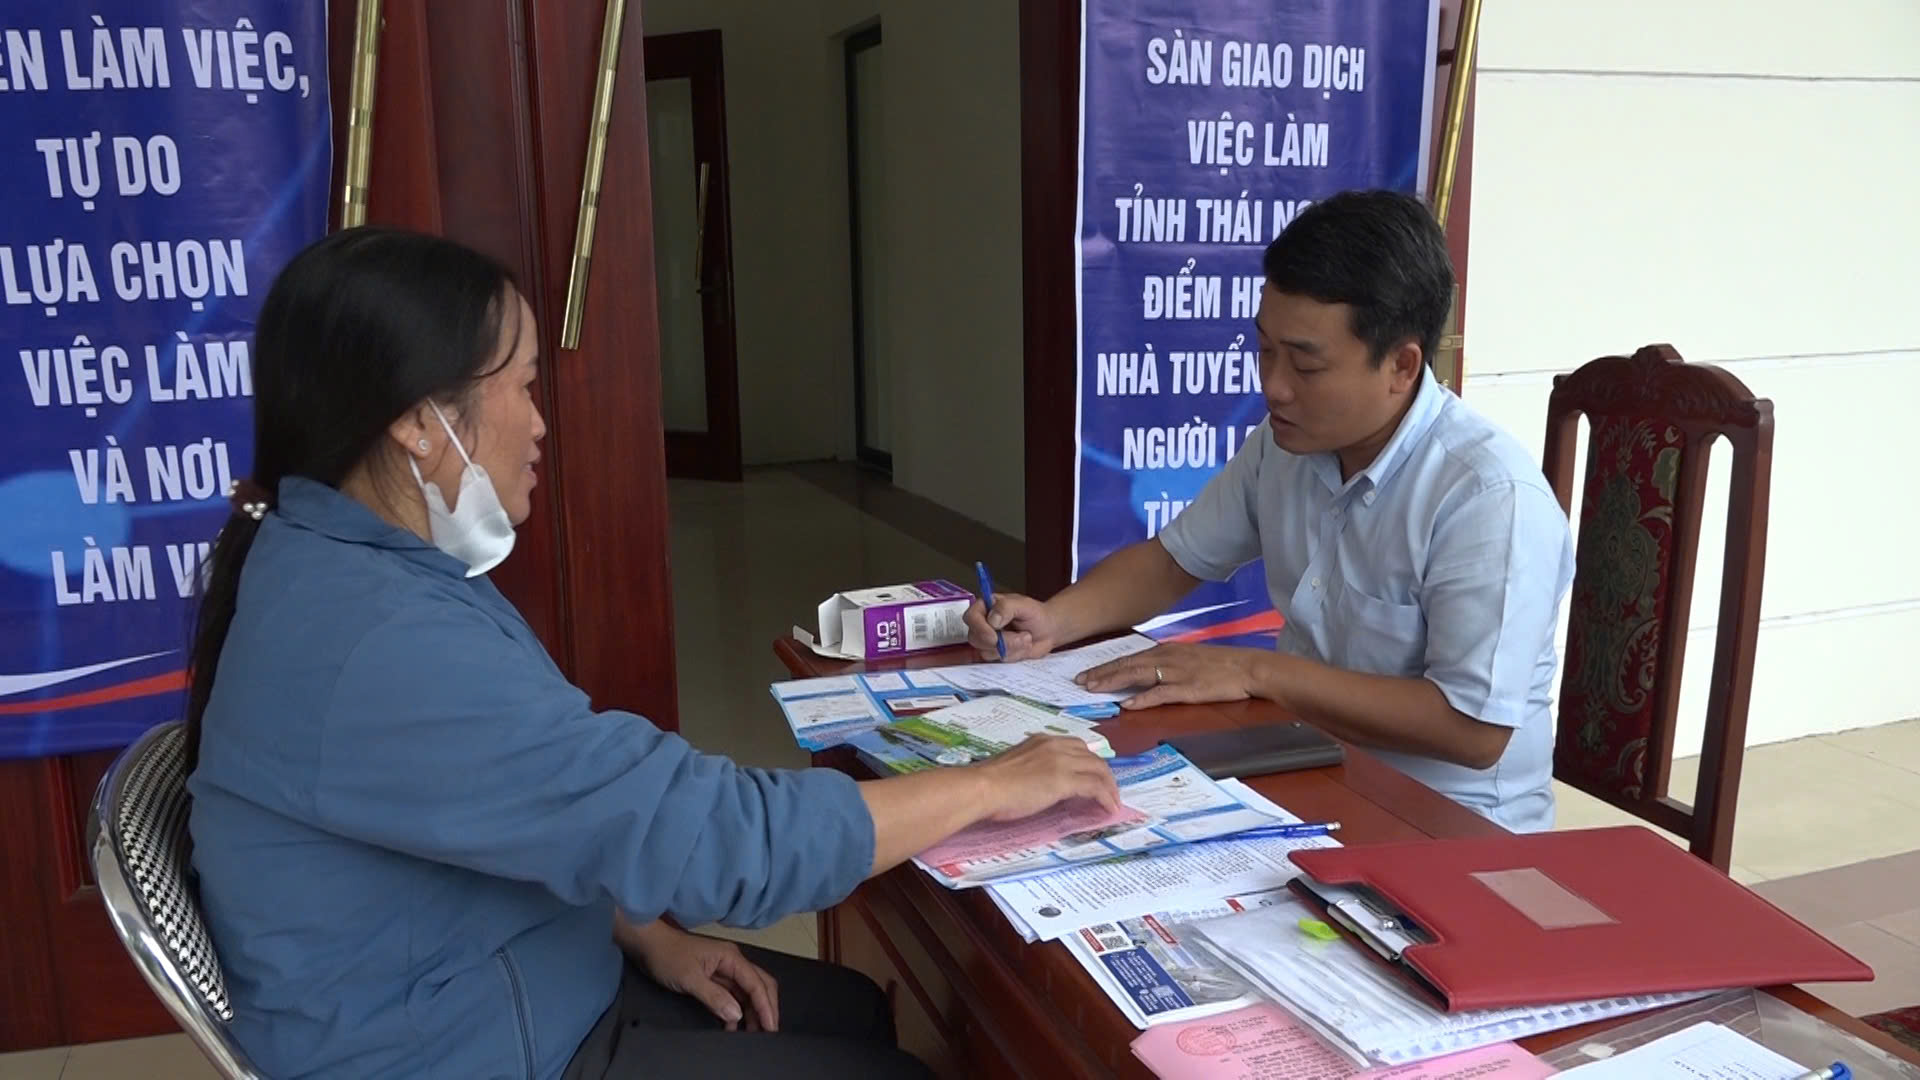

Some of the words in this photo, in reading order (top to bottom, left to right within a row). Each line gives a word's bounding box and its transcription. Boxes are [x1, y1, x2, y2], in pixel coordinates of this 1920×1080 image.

[60, 15, 171, 90] LÀM
[182, 18, 310, 104] VIỆC,
[1146, 29, 1212, 85] SÀN
[1221, 41, 1293, 88] GIAO
[1303, 44, 1365, 99] DỊCH
[35, 131, 101, 210] TỰ
[113, 135, 181, 196] DO
[1188, 111, 1254, 175] VIỆC
[1264, 113, 1329, 167] LÀM
[1115, 183, 1187, 242] TỈNH
[1196, 190, 1263, 242] THÁI
[1272, 200, 1313, 242] N
[0, 239, 100, 316] LỰA
[110, 239, 248, 311] CHỌN
[1143, 258, 1222, 319] ĐIỂM
[19, 335, 133, 417] VIỆC
[144, 331, 254, 402] LÀM
[1097, 344, 1160, 396] NHÀ
[1169, 334, 1262, 394] TUYỂN
[69, 435, 136, 504] VÀ
[145, 437, 231, 501] NƠI
[1123, 416, 1216, 470] NGƯỜI
[51, 537, 156, 606] LÀM
